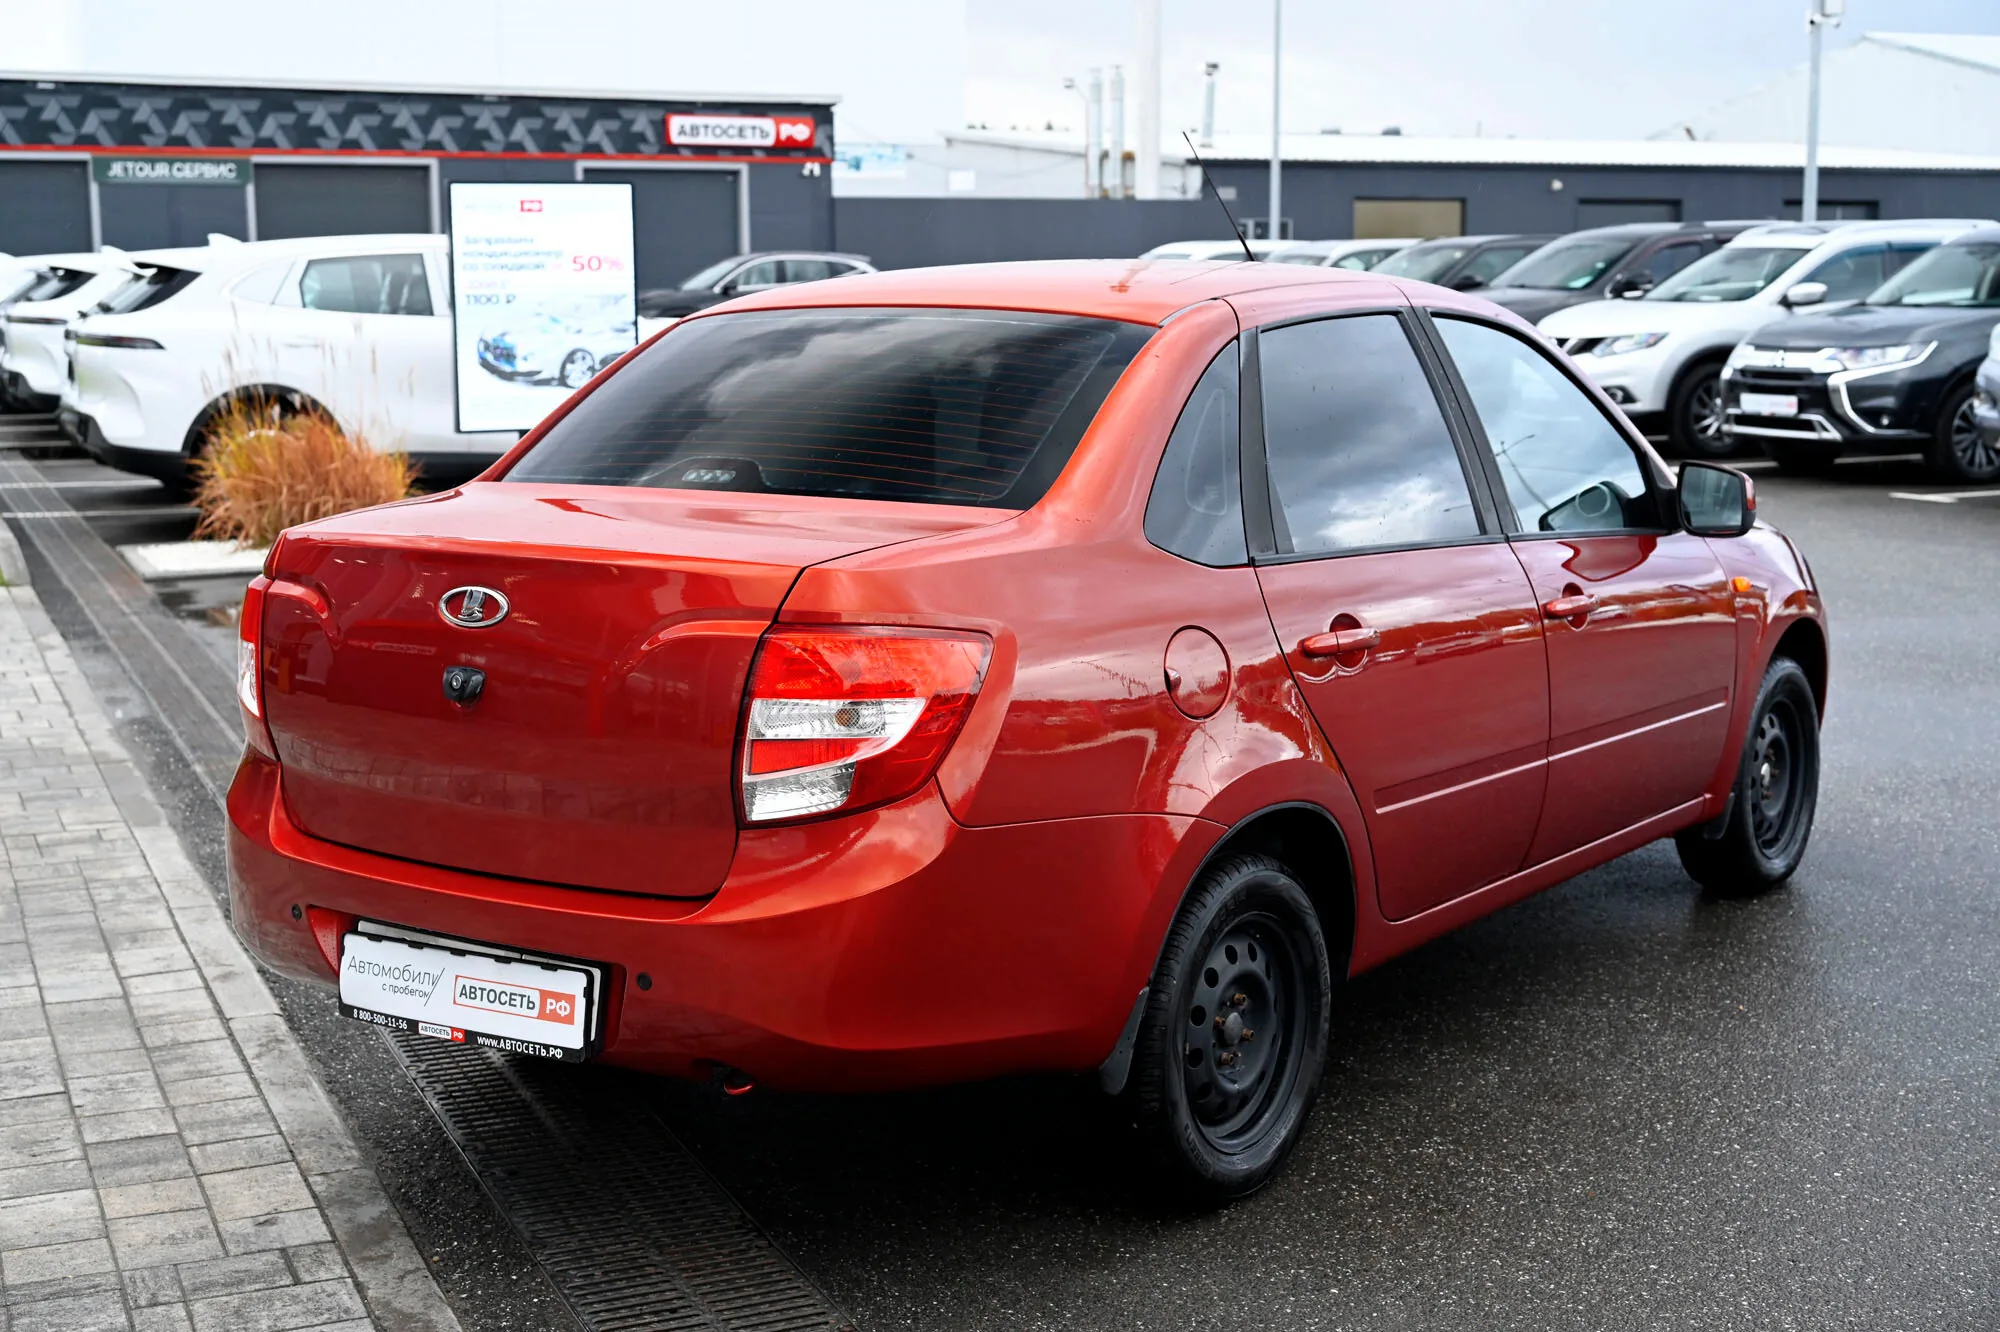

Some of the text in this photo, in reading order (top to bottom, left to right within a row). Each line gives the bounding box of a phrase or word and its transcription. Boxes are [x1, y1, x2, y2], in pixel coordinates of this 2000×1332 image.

[677, 122, 811, 142] АВТОСЕТЬ РФ
[107, 160, 238, 180] JETOUR СЕРВИС
[388, 984, 431, 999] пробегом
[458, 984, 571, 1017] АВТОСЕТЬ РФ
[353, 1008, 408, 1030] 8 800-500-11-56
[420, 1025, 463, 1039] АВТОСЕТЬ РФ
[476, 1035, 563, 1059] www.АВТОСЕТЬ.РФ
